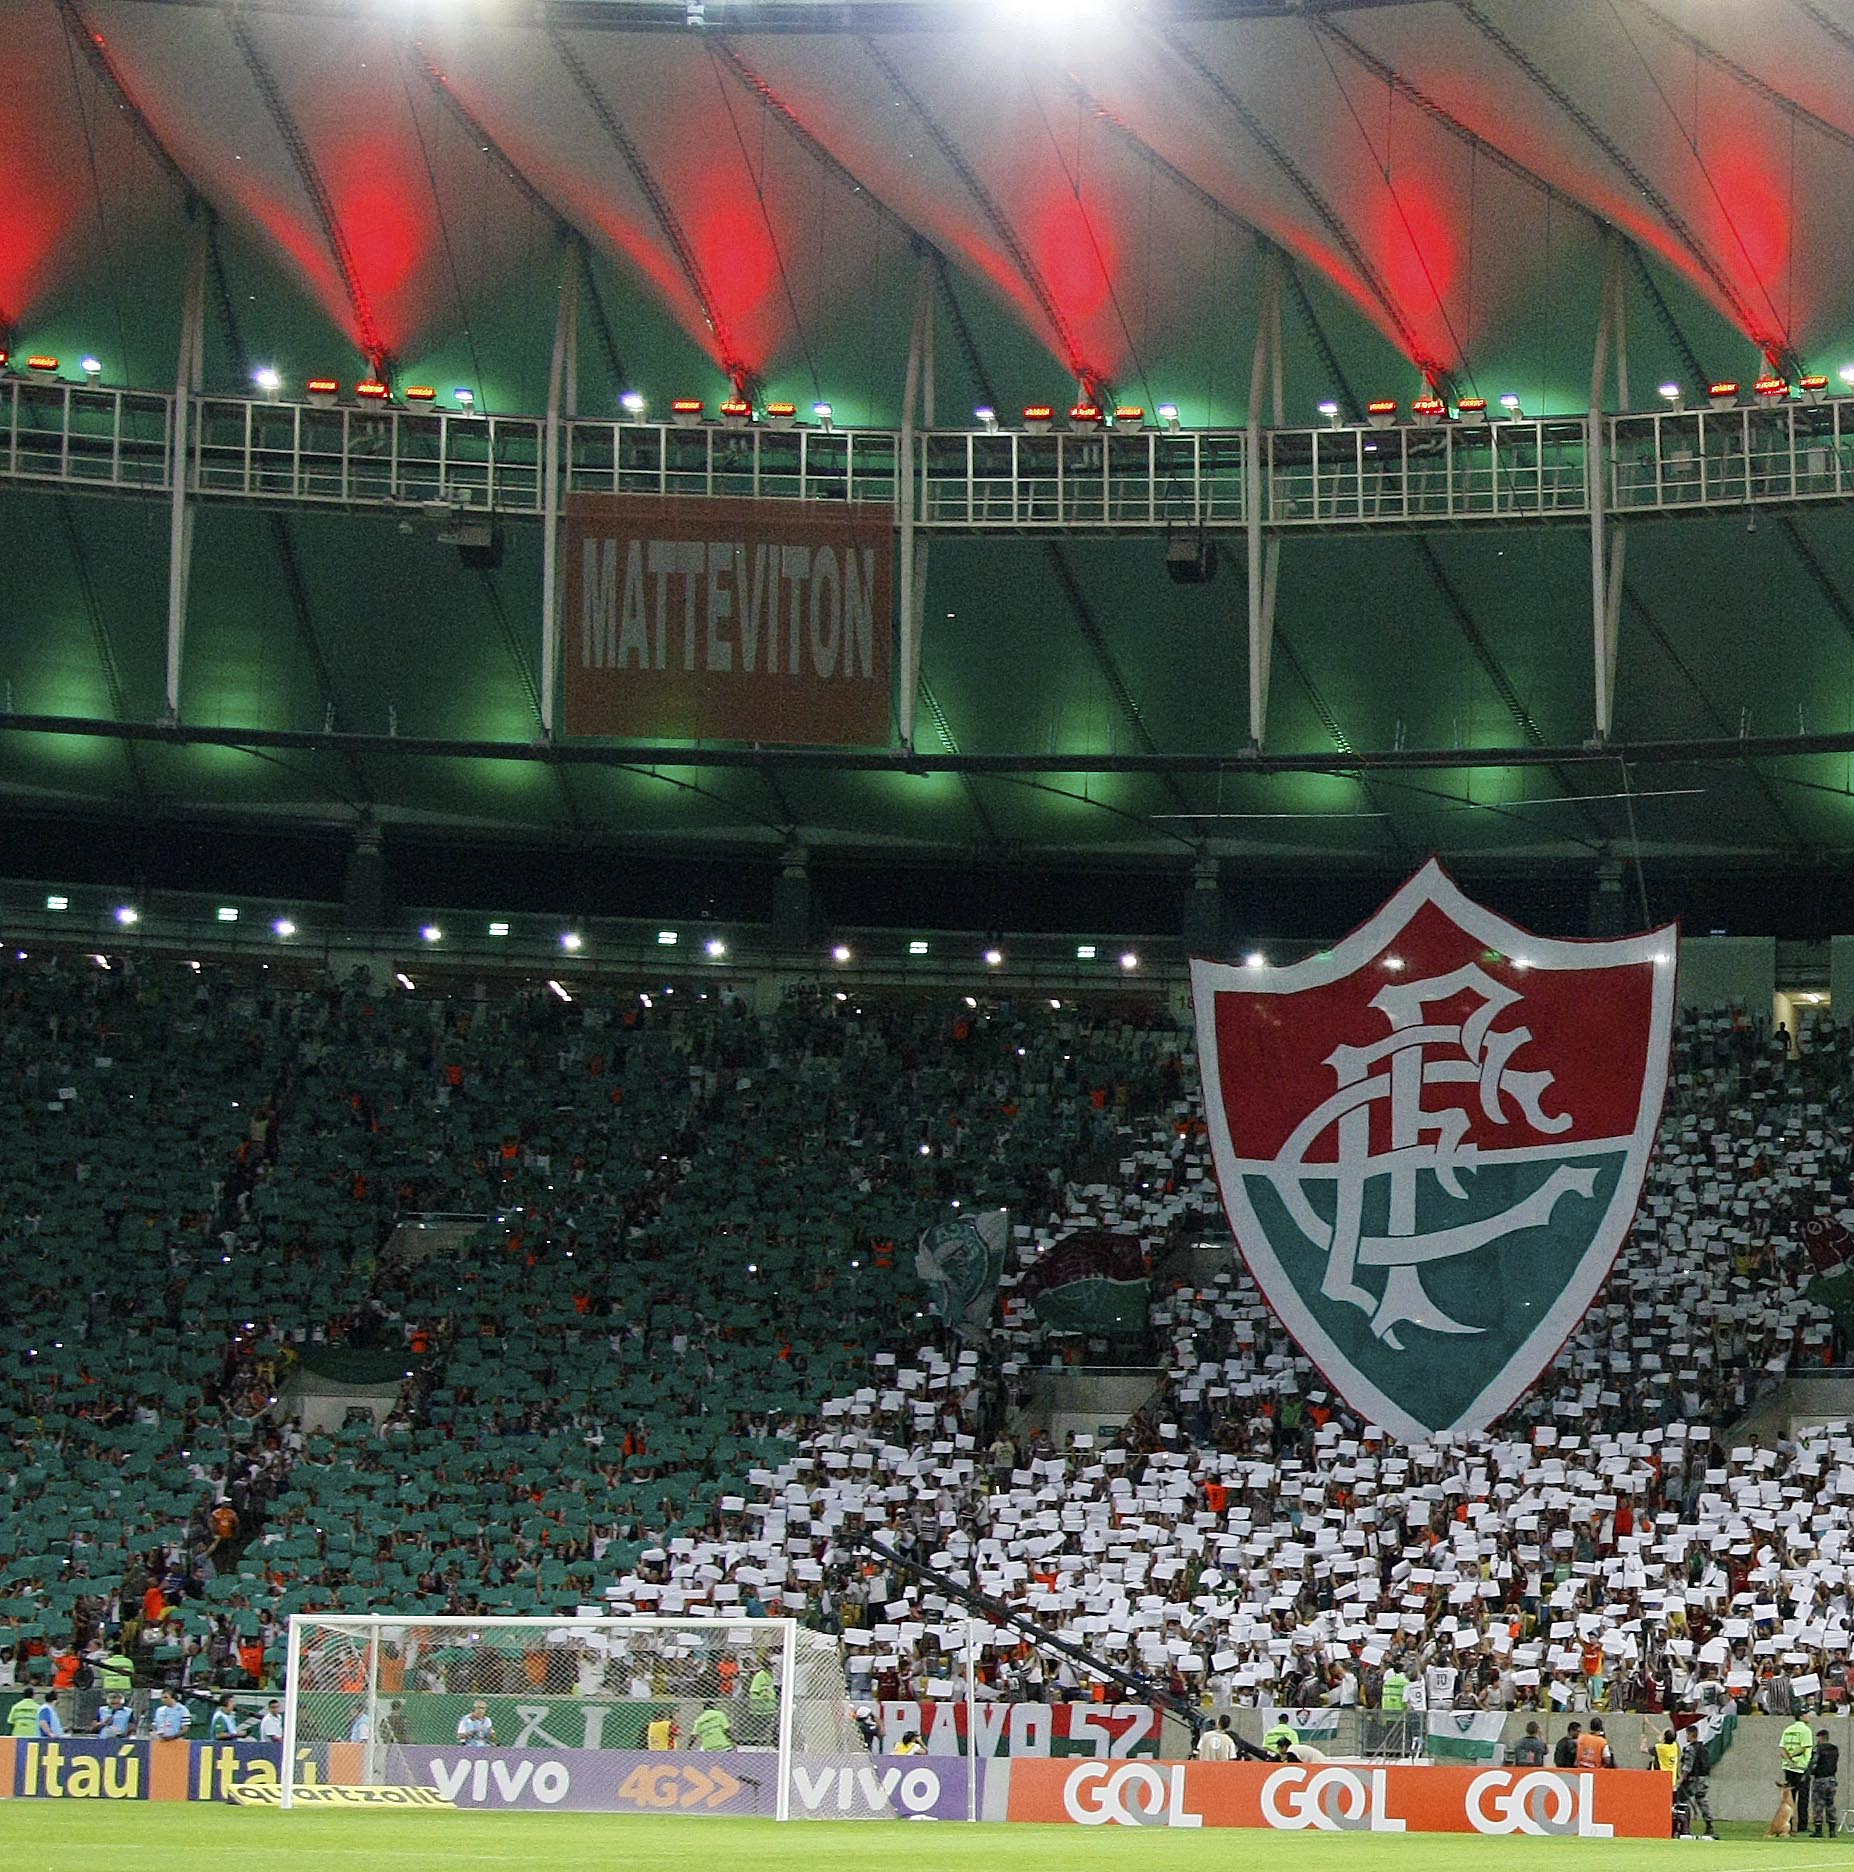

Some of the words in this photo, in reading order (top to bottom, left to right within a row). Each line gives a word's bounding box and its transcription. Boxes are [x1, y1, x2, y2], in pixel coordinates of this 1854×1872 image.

[581, 537, 875, 679] MATTEVITON
[1068, 1702, 1155, 1760] 52
[24, 1742, 140, 1799] Itaú
[618, 1764, 681, 1806] 4G
[1063, 1761, 1204, 1828] GOL
[1260, 1766, 1407, 1832] GOL
[1465, 1769, 1615, 1838] GOL
